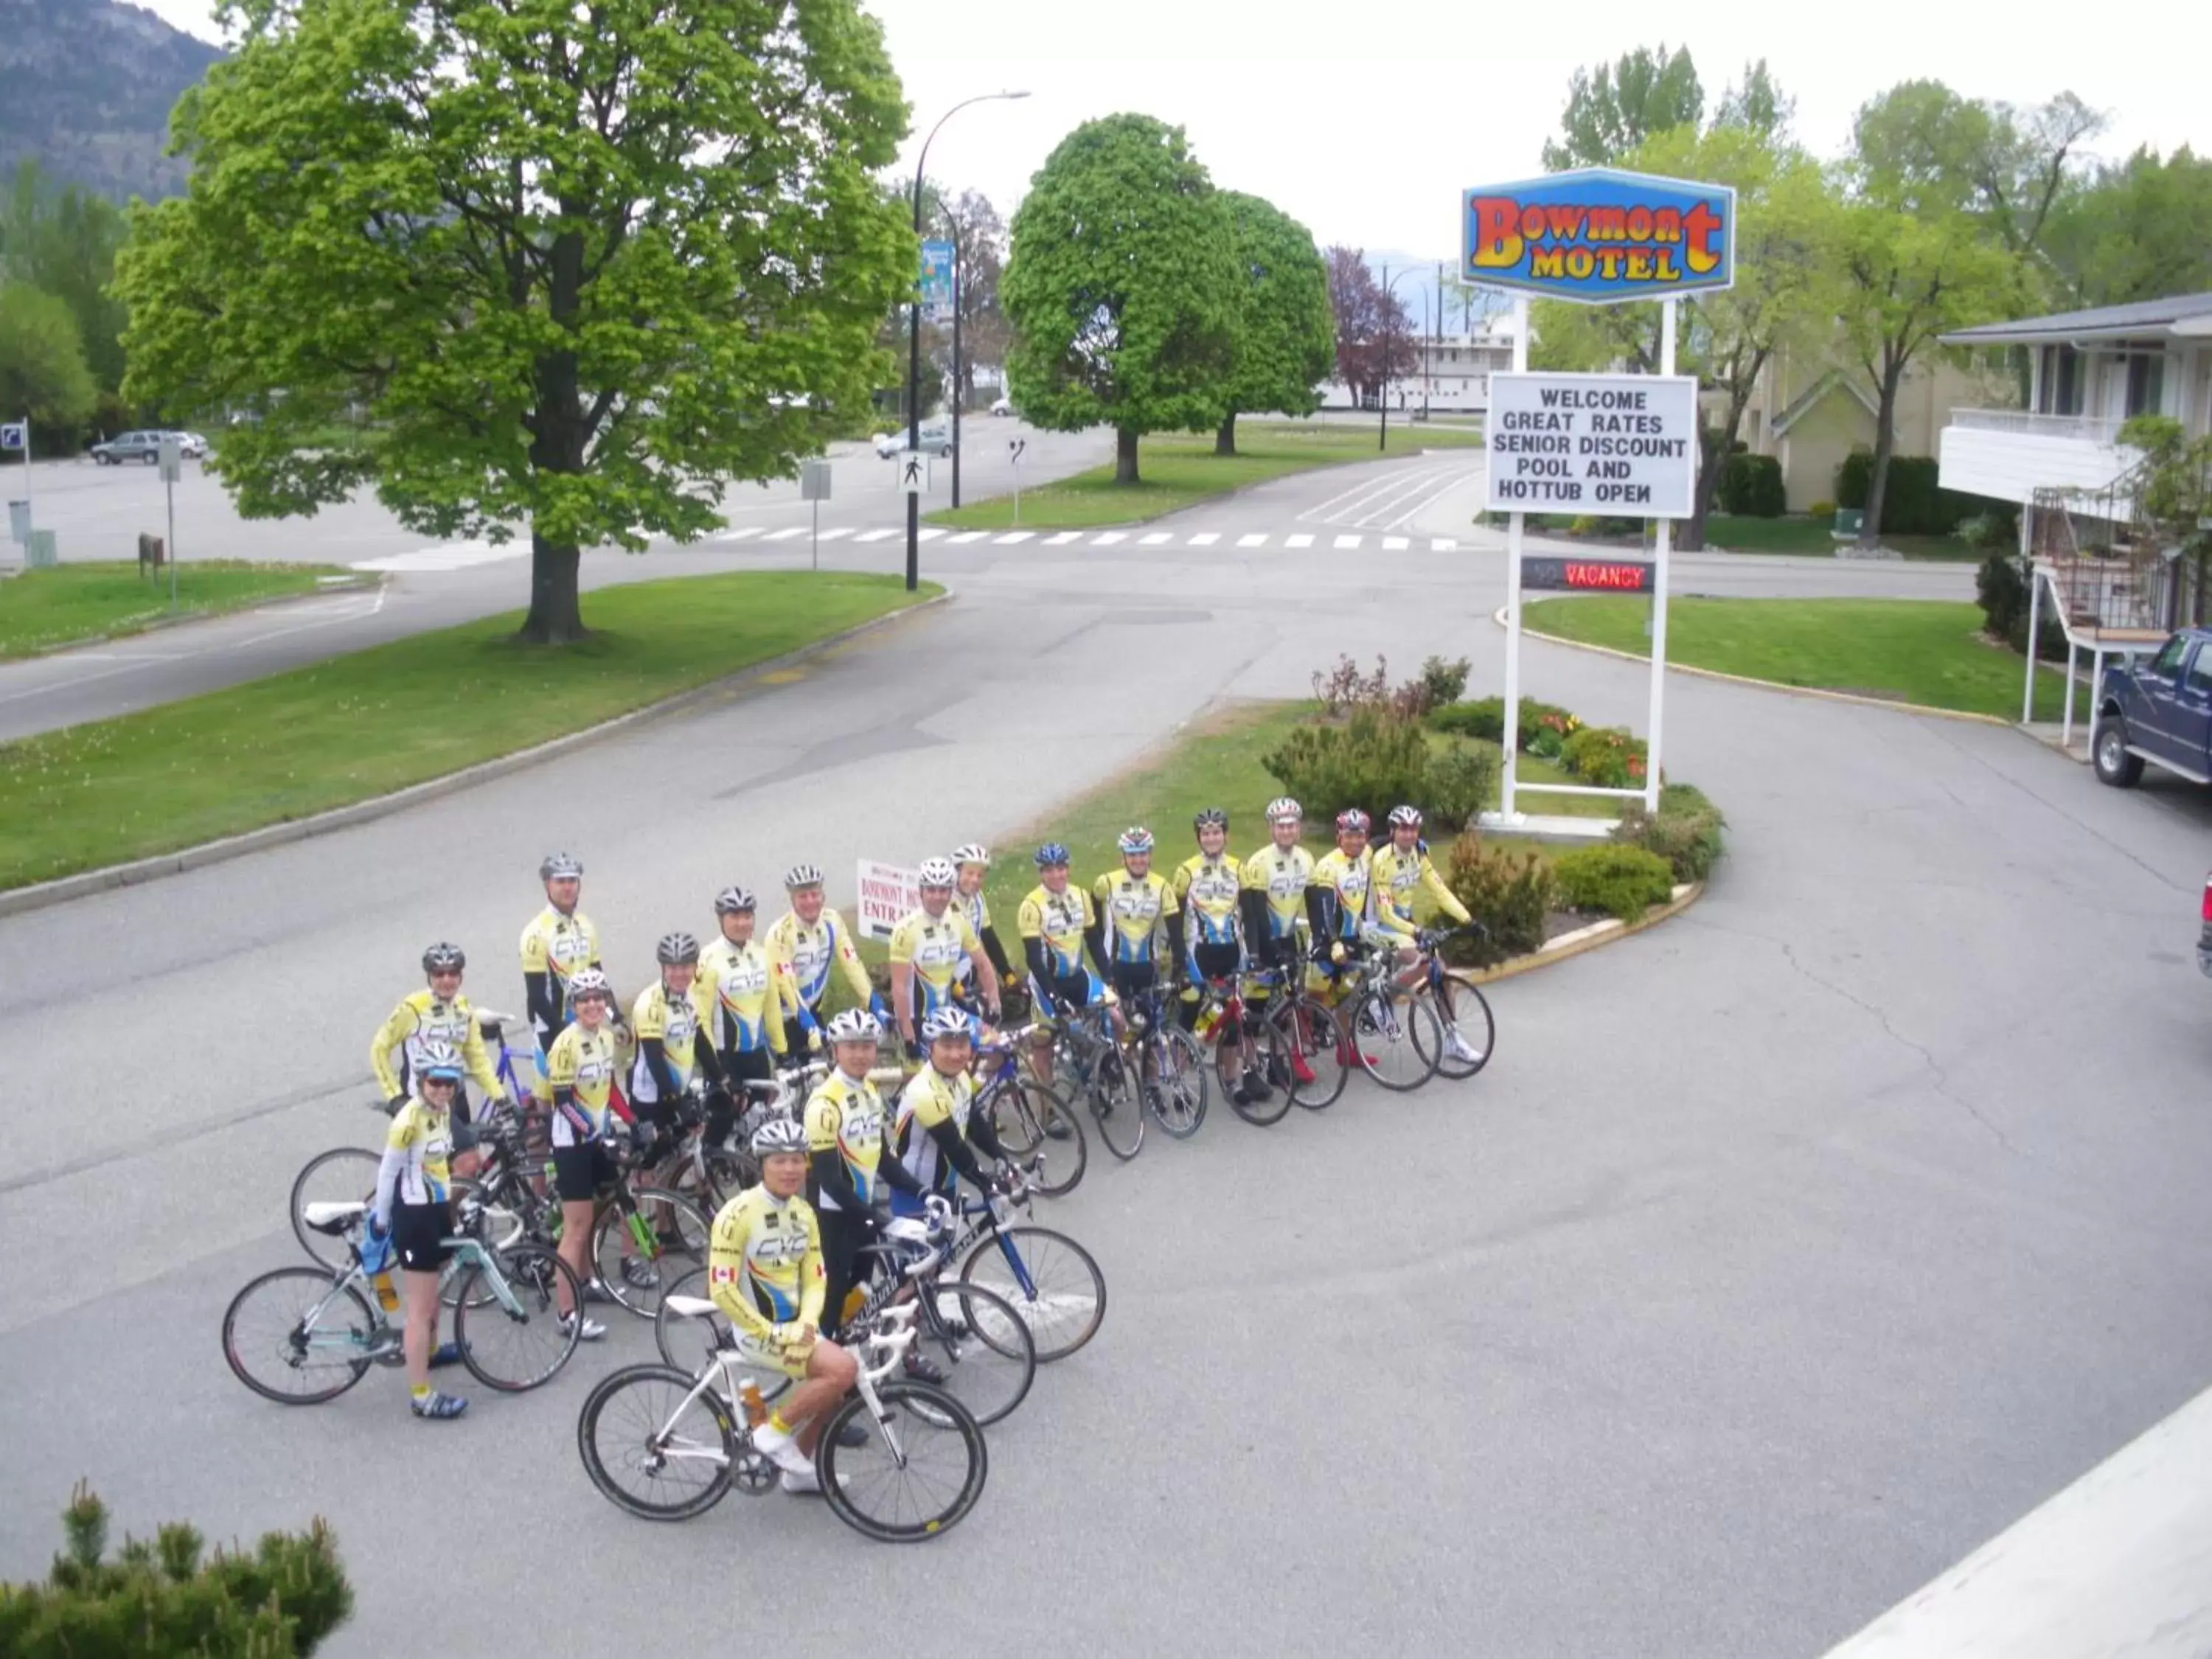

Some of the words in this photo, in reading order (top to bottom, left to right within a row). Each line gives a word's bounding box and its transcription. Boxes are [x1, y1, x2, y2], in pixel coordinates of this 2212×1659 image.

[1530, 246, 1682, 282] MOTEL
[1540, 389, 1647, 410] WELCOME
[1503, 412, 1574, 431] GREAT
[1592, 414, 1663, 434] RATES
[1493, 434, 1571, 453] SENIOR
[1579, 437, 1686, 457] DISCOUNT
[1517, 458, 1573, 476] POOL
[1586, 460, 1632, 479] AND
[1498, 480, 1582, 500] HOTTUB
[1595, 483, 1651, 503] OPEN
[1565, 563, 1645, 588] VACANCY
